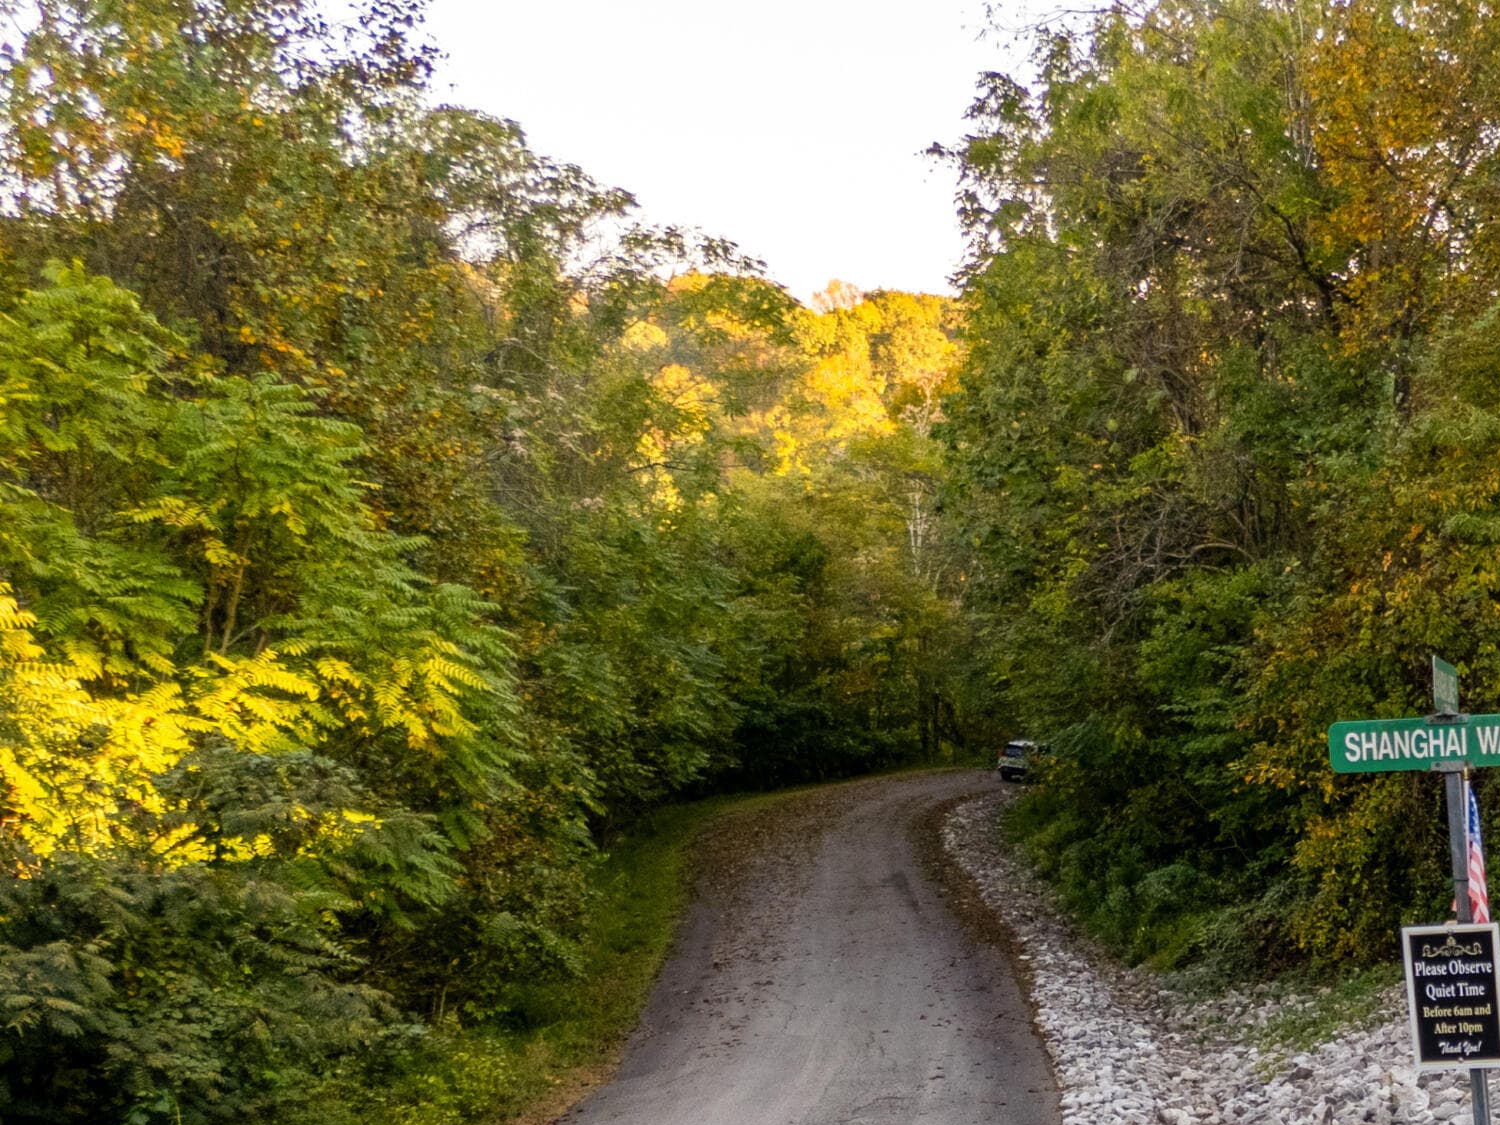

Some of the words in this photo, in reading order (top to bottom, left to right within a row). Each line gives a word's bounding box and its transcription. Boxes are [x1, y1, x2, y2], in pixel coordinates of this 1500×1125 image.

[1345, 727, 1468, 762] SHANGHAI
[1414, 962, 1447, 977] Please
[1449, 960, 1493, 976] Observe
[1425, 984, 1456, 1000] Quiet
[1457, 983, 1485, 996] Time
[1423, 1006, 1452, 1018] Before
[1453, 1005, 1473, 1017] 6am
[1474, 1004, 1492, 1015] and
[1434, 1023, 1457, 1034] After
[1458, 1022, 1483, 1035] 10pm
